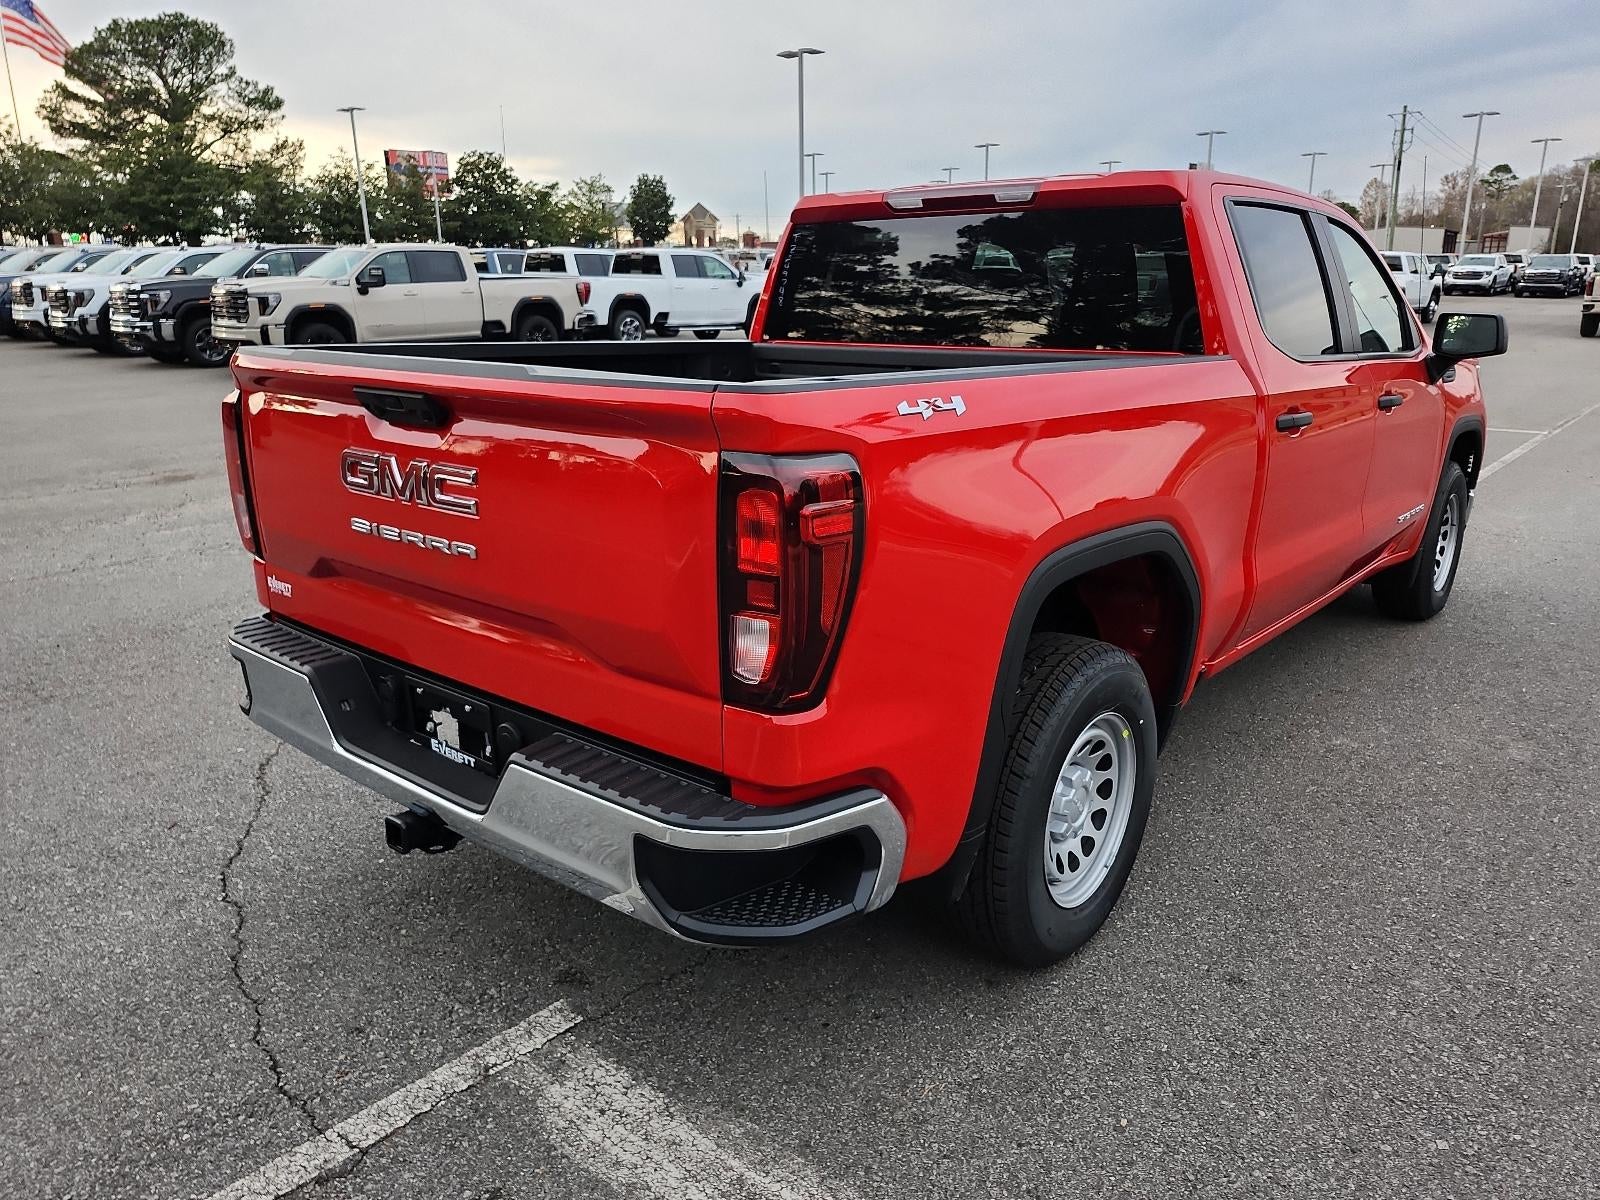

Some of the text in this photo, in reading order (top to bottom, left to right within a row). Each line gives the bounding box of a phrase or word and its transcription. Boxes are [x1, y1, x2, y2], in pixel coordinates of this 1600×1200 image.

[340, 447, 479, 519] GMC
[350, 517, 477, 559] SIERRA
[430, 738, 476, 767] EVERETT
